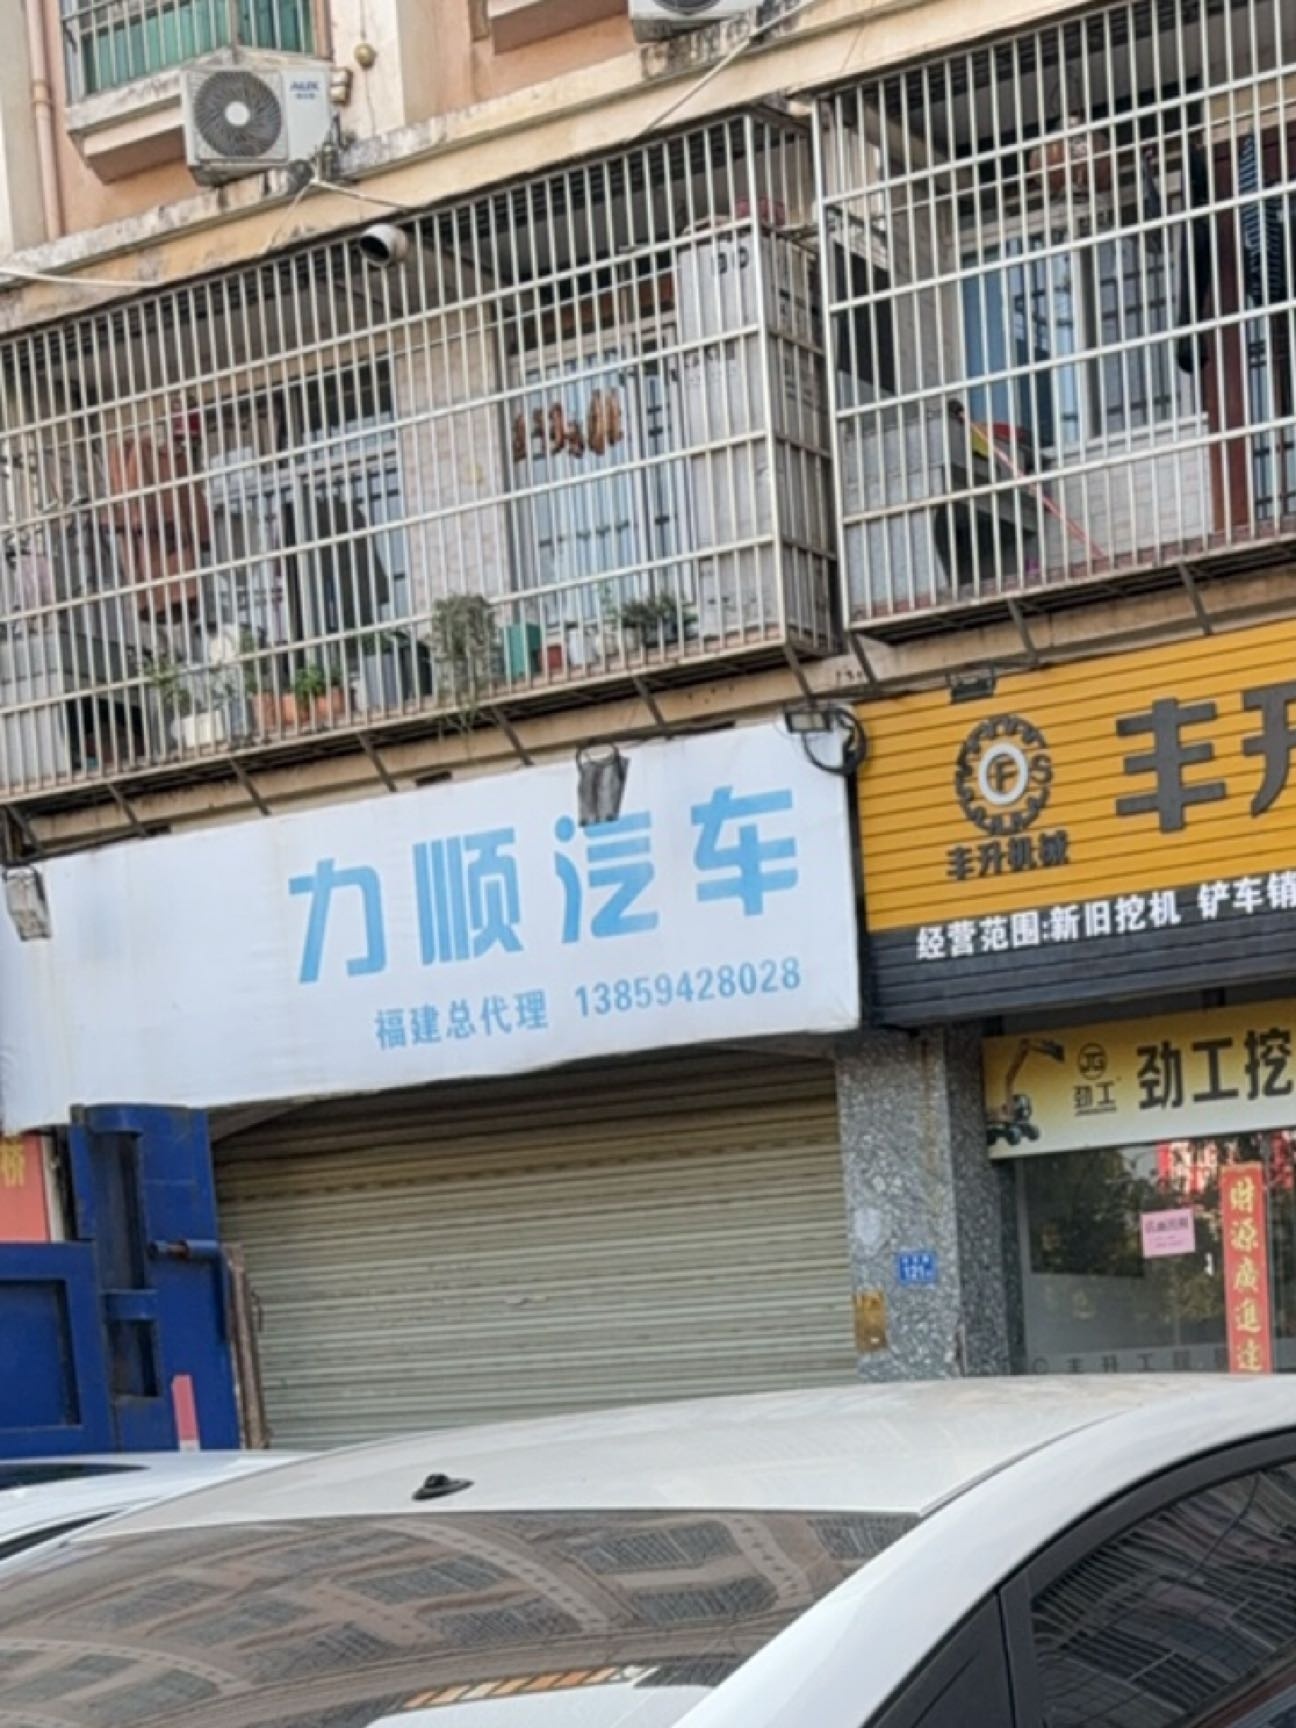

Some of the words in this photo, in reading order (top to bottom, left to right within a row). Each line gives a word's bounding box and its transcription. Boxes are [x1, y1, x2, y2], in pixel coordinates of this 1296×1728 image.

[288, 785, 800, 984] 力顺汽车
[946, 829, 1070, 881] 丰升机械
[916, 890, 1181, 960] 经营范围:新旧挖机
[374, 987, 549, 1051] 福建总代理
[574, 956, 801, 1018] 13859428028
